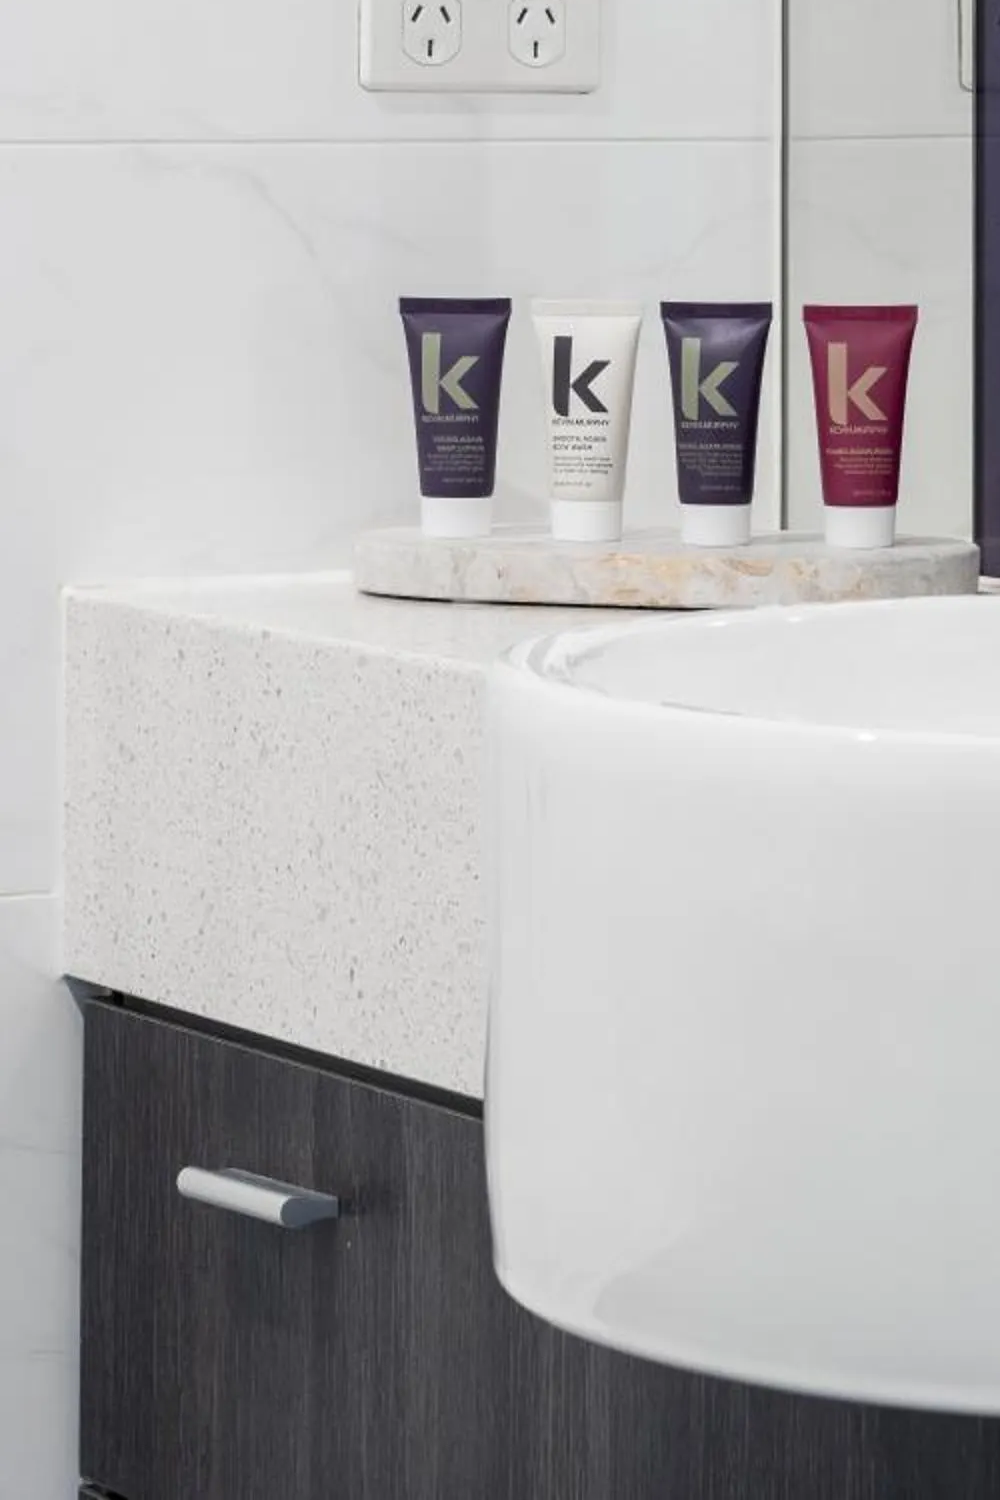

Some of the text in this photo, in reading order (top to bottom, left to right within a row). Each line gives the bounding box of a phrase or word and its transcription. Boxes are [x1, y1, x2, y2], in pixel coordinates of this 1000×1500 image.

[421, 332, 479, 414] k
[552, 336, 610, 417] k
[681, 337, 739, 421] k
[827, 341, 888, 425] k
